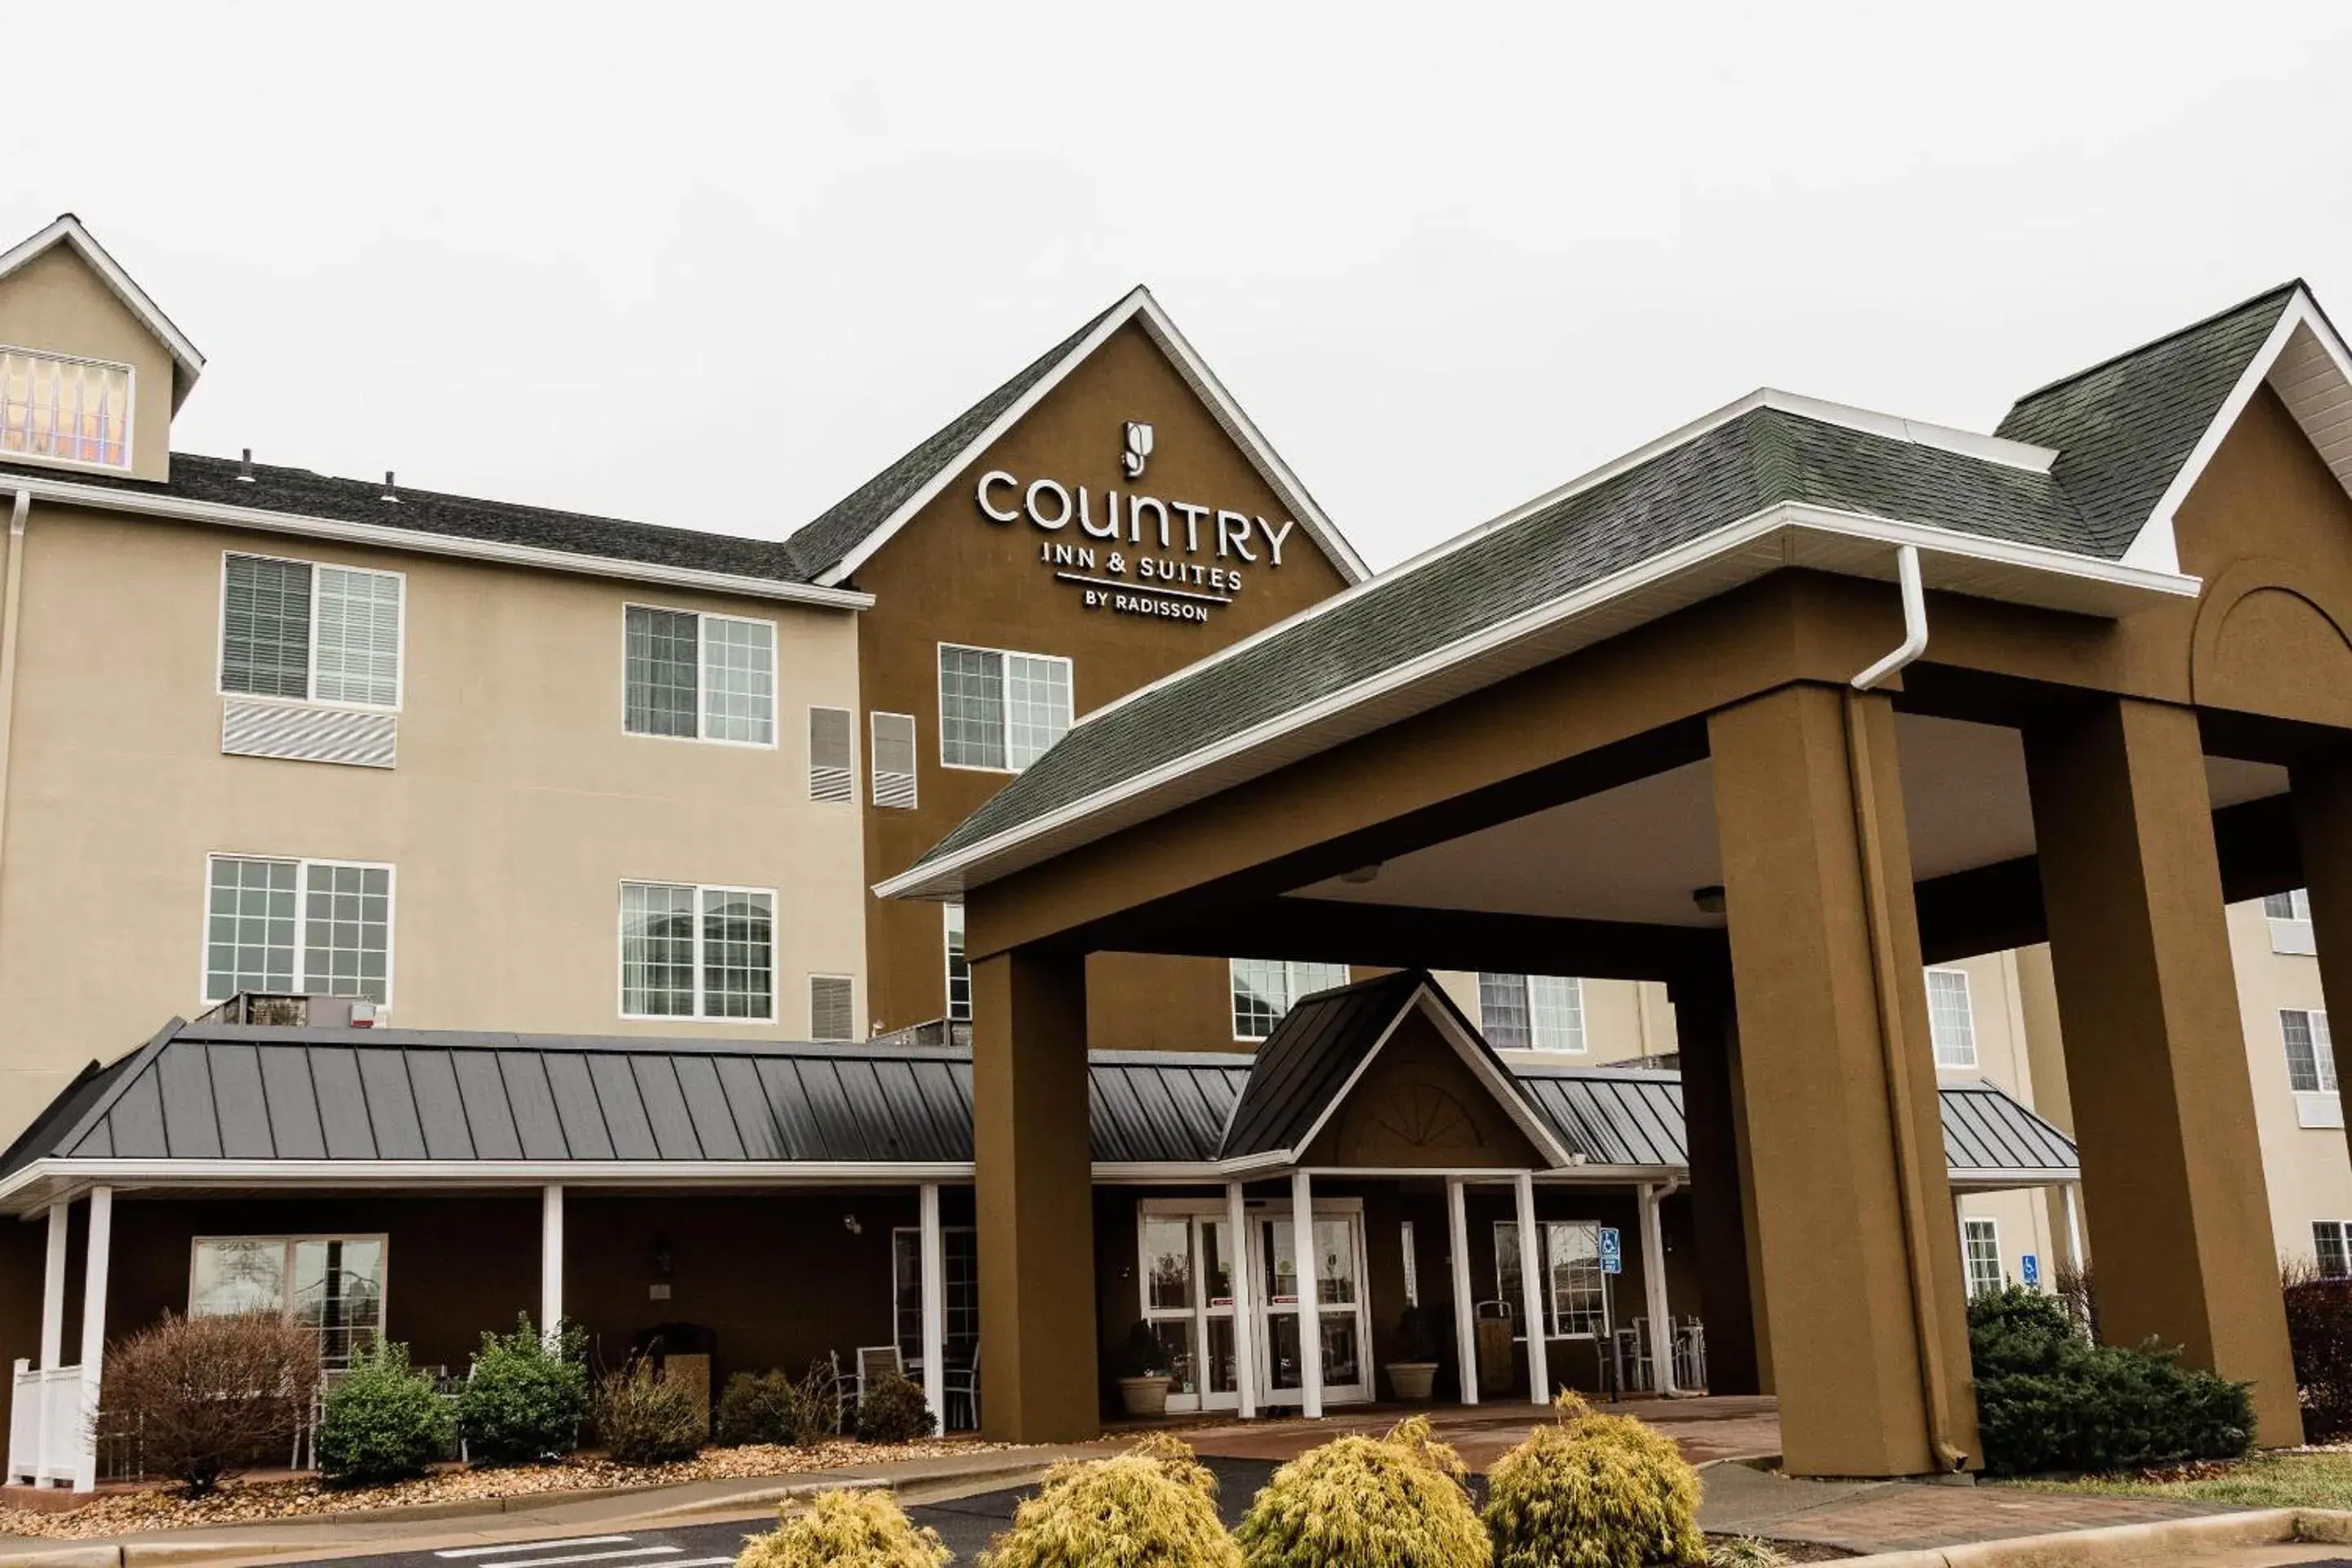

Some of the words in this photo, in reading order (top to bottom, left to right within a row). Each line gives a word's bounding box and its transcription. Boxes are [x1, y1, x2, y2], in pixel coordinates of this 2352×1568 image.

[1042, 543, 1095, 568] INN
[1109, 552, 1126, 572] &
[1140, 558, 1241, 590] SUITES
[1086, 590, 1109, 606] BY
[1116, 595, 1208, 621] RADISSON
